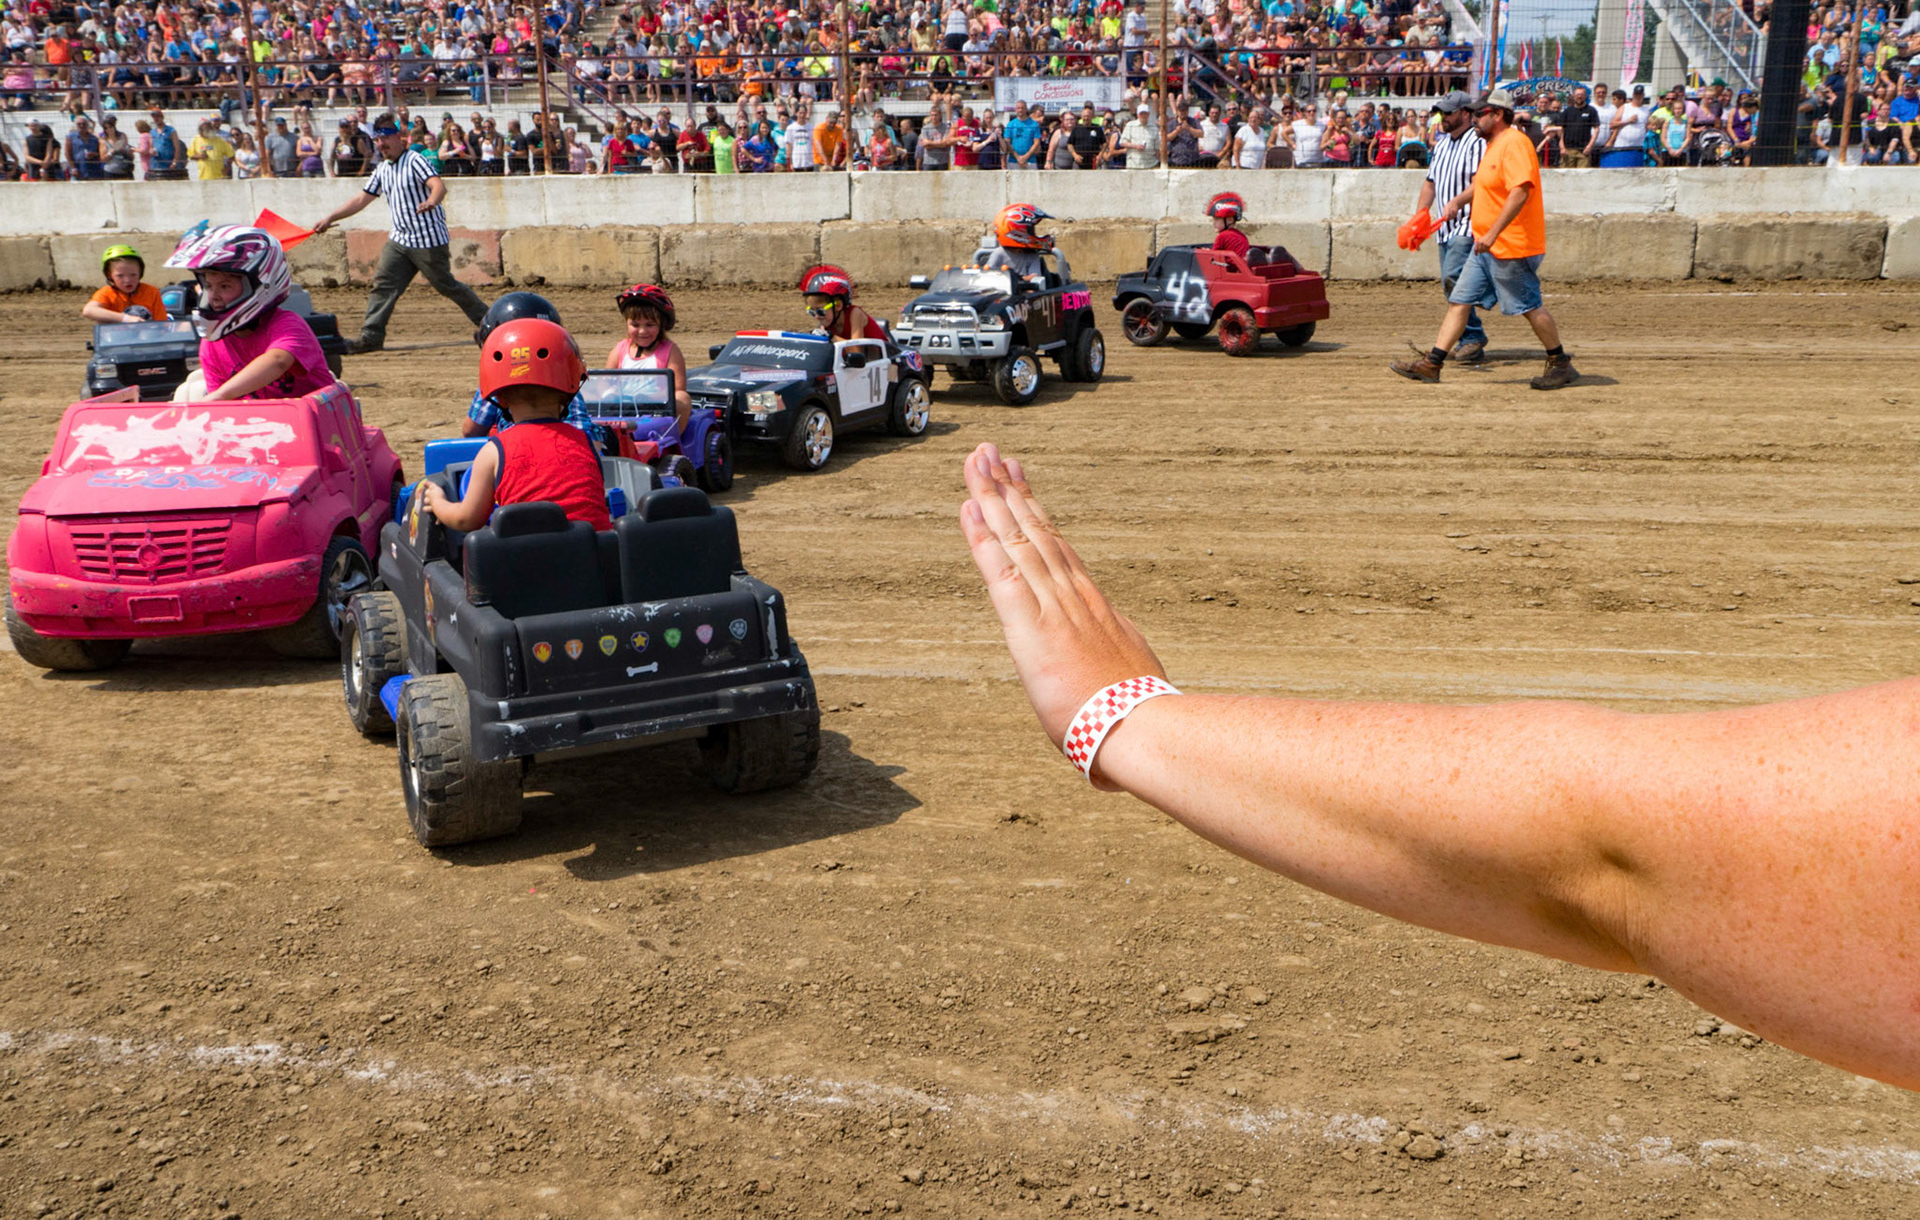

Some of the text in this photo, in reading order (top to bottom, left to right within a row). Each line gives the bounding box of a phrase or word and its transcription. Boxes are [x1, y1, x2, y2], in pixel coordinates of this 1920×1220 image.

[1535, 80, 1573, 95] CREA
[1041, 294, 1057, 328] 41
[510, 346, 531, 365] 95
[751, 344, 811, 361] Motorsports
[137, 366, 168, 376] GMC
[867, 366, 882, 404] 14
